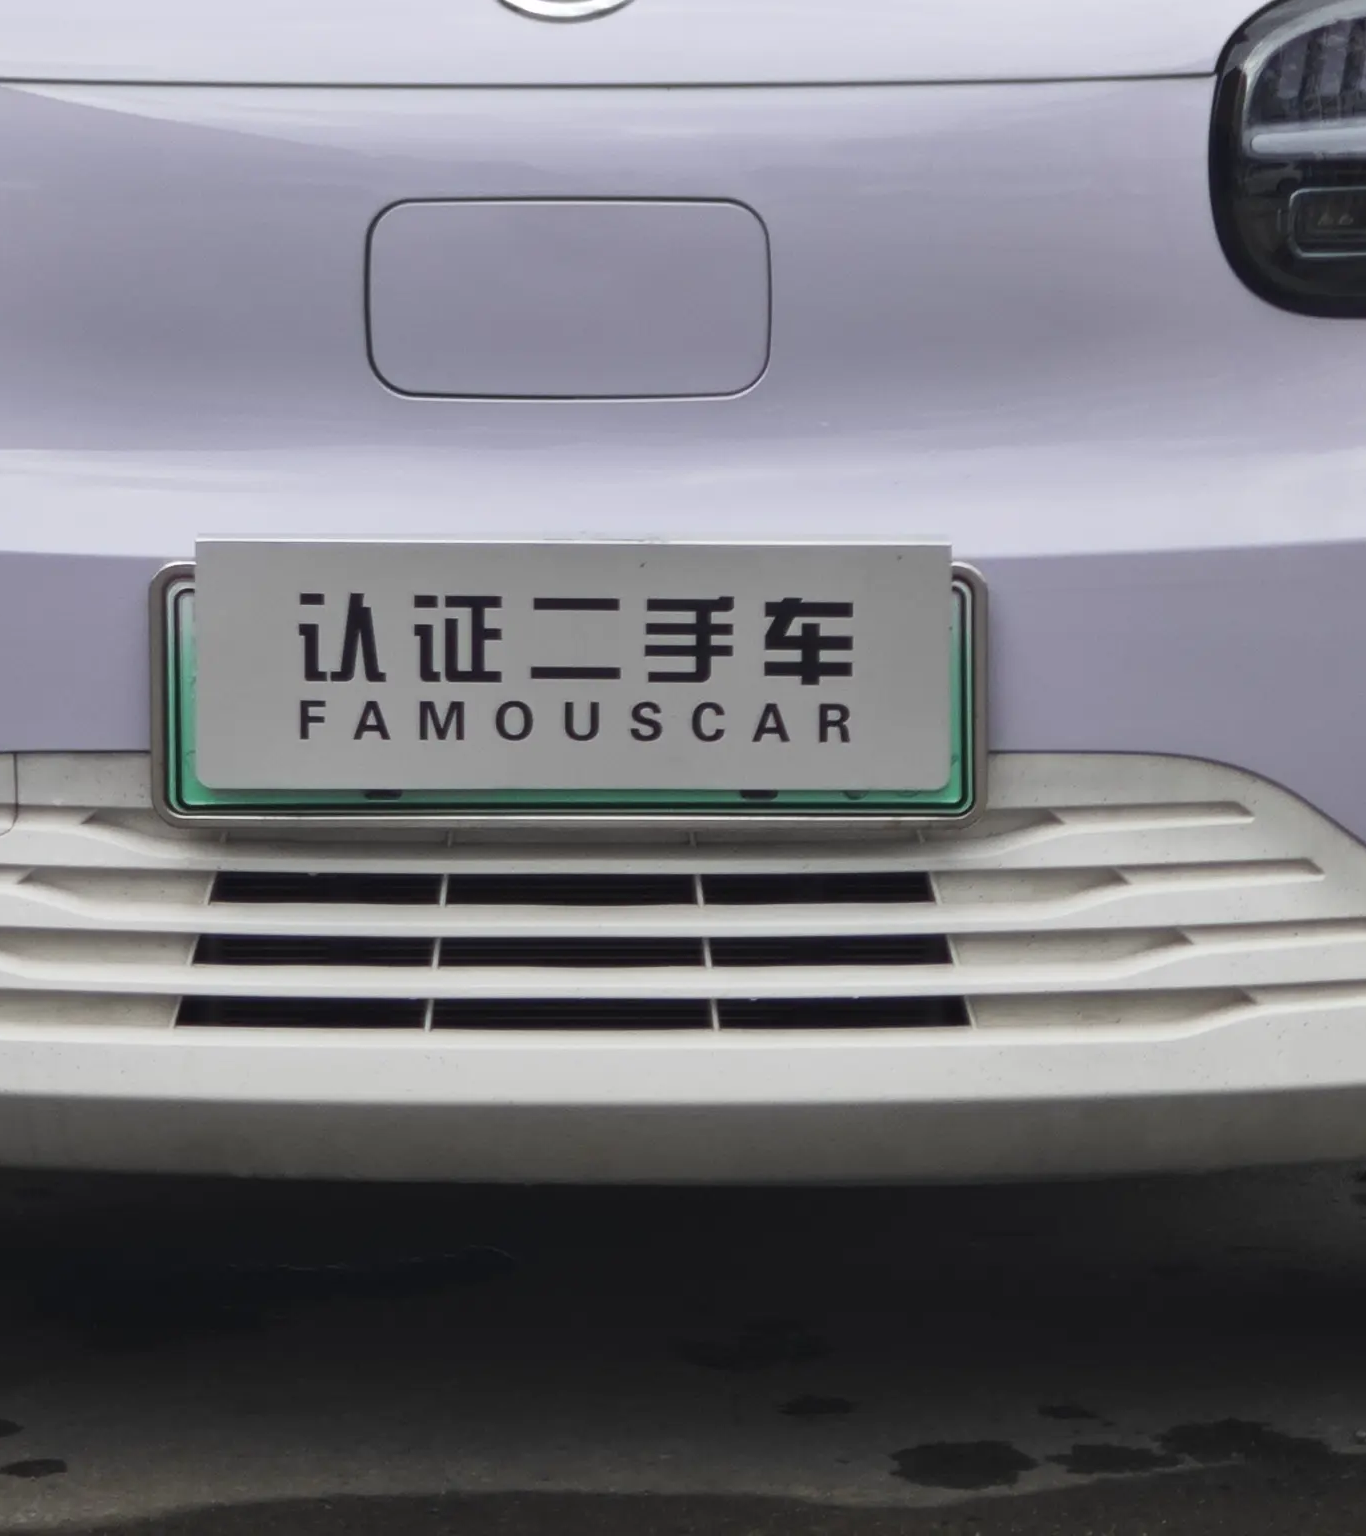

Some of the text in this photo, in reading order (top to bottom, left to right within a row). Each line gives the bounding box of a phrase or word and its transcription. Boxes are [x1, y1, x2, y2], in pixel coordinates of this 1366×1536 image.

[298, 592, 854, 686] 认证二手车
[299, 700, 852, 743] FAMOUSCAR
